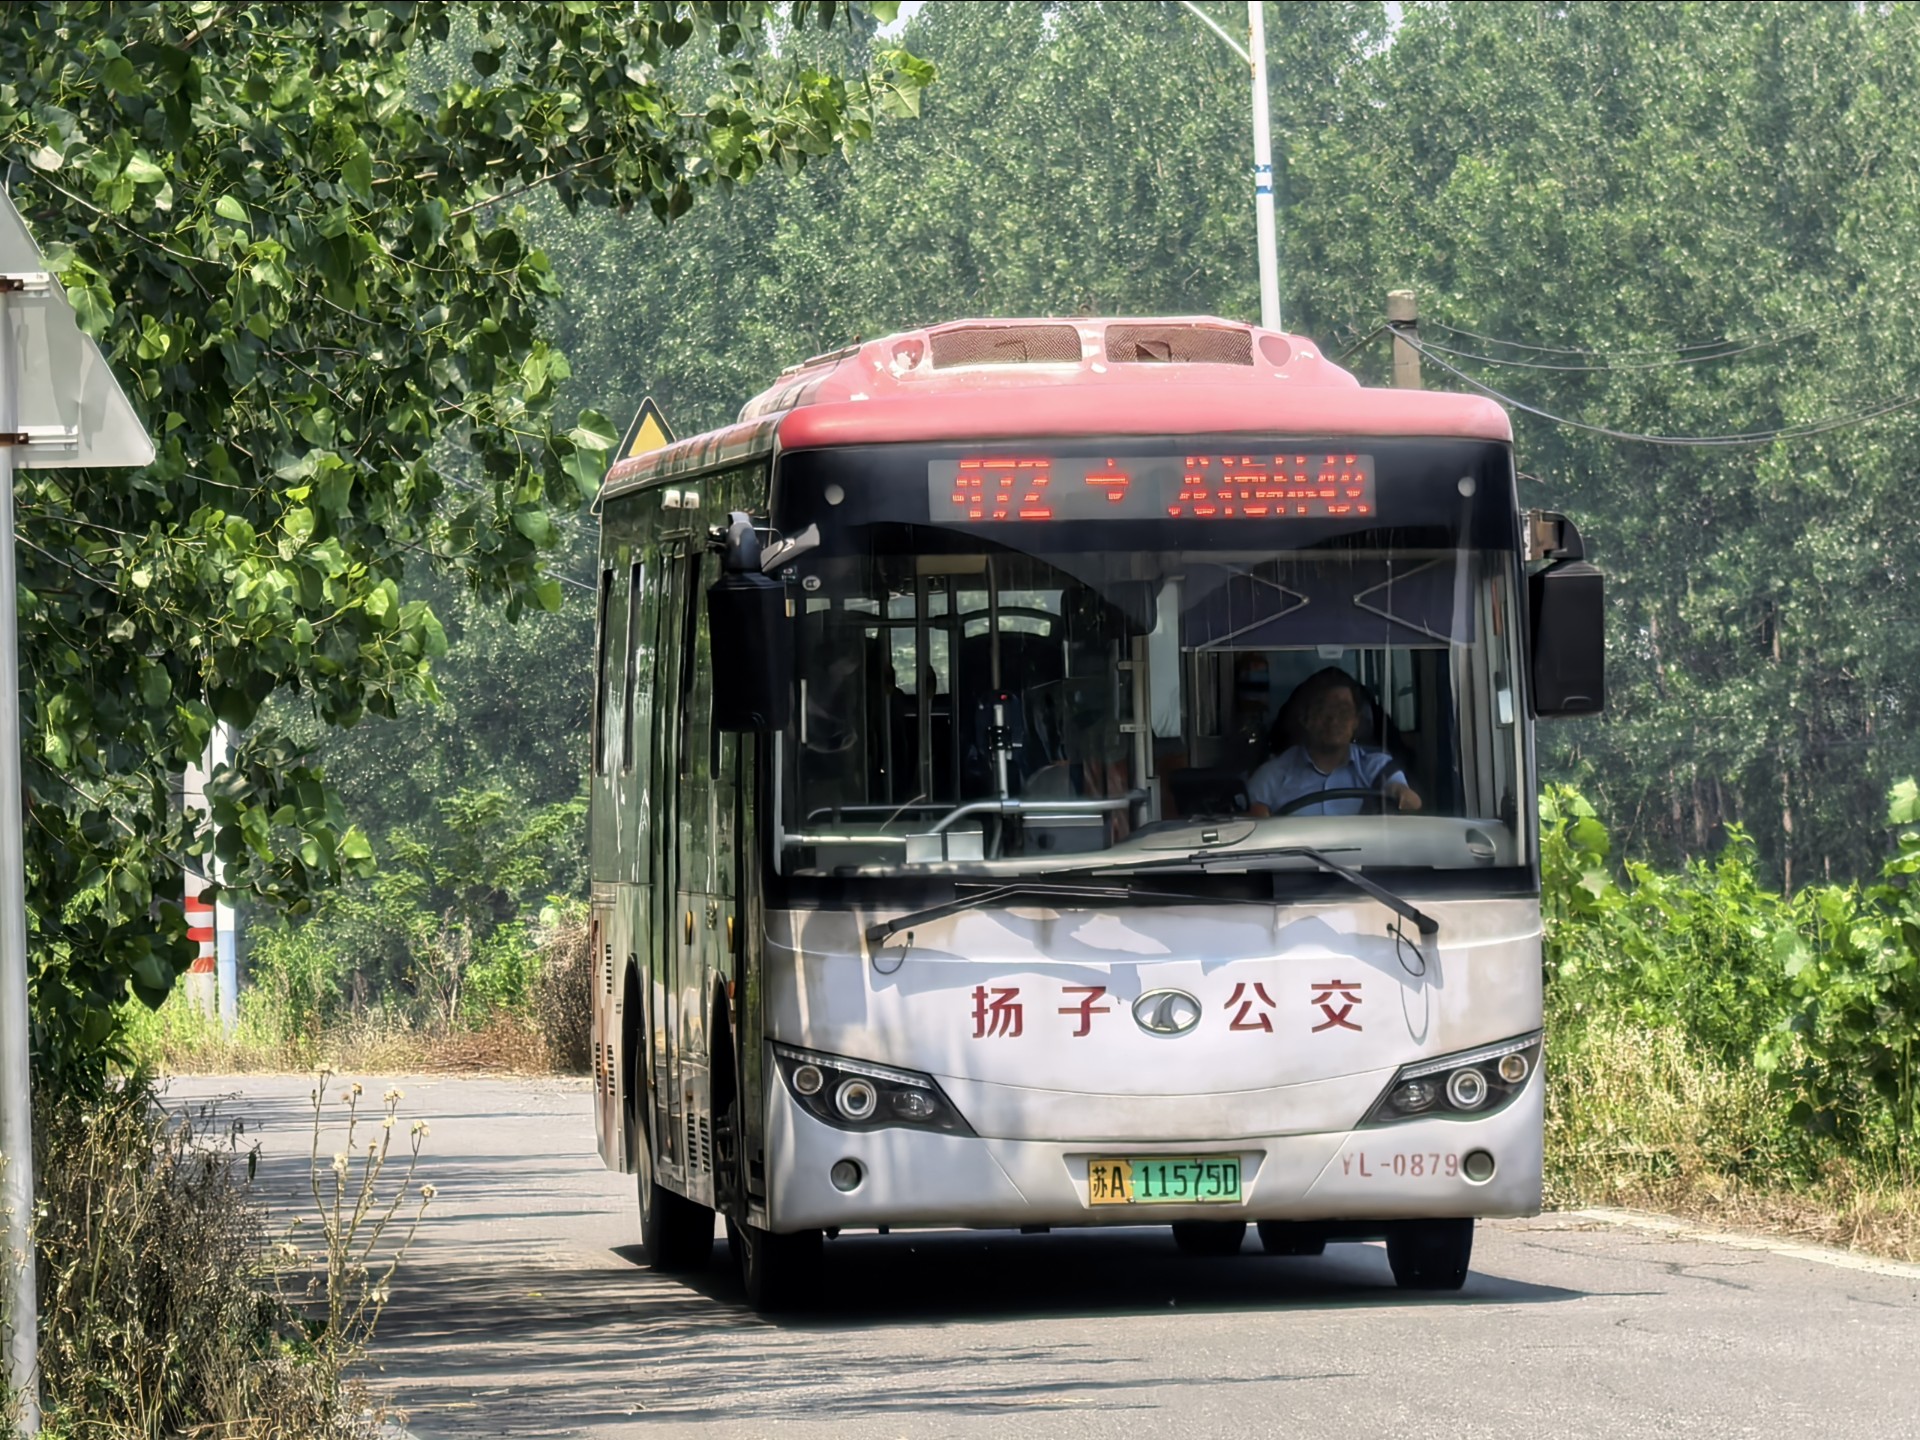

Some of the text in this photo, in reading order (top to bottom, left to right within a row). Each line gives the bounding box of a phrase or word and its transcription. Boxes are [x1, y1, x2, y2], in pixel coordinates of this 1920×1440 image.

[971, 978, 1363, 1038] 扬子 公交
[1342, 1151, 1458, 1177] YL-0879
